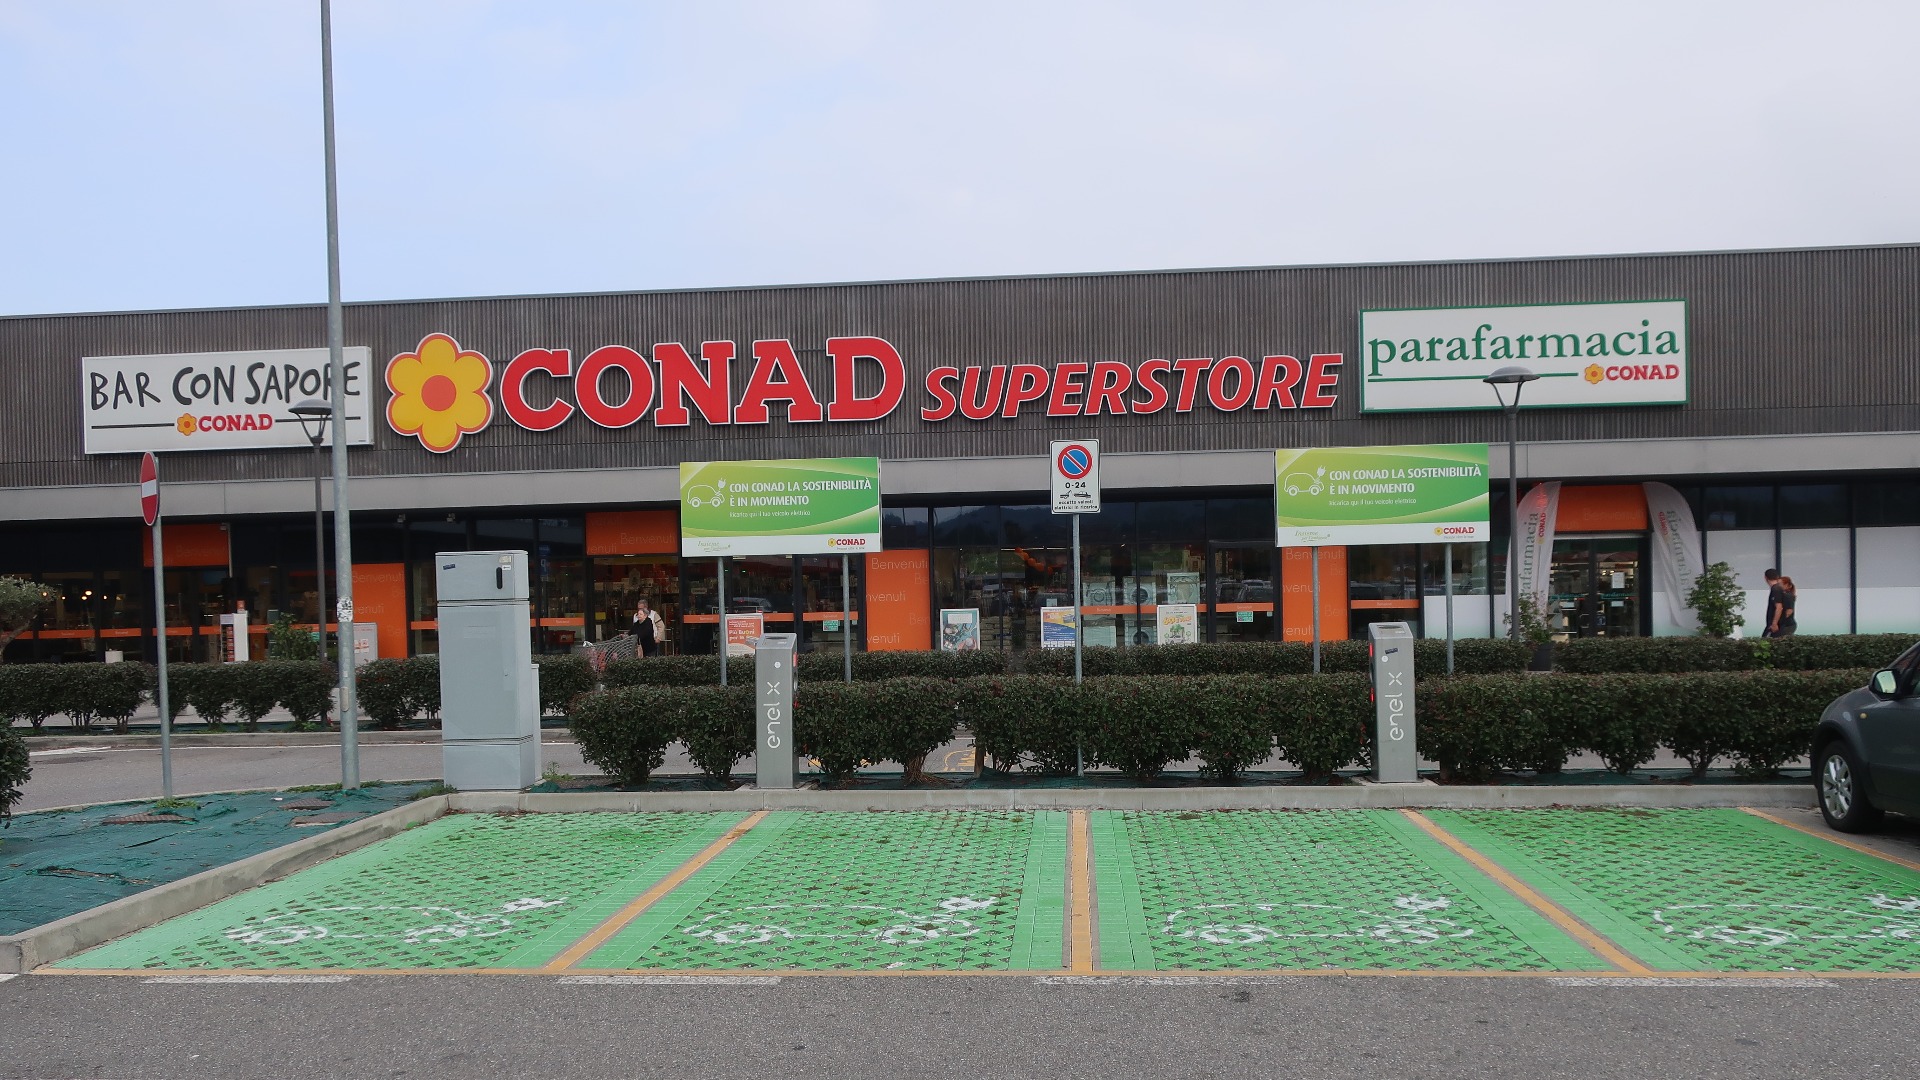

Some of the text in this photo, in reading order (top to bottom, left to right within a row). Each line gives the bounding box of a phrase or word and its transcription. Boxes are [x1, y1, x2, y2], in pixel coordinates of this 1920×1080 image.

[1368, 319, 1680, 376] parafarmacia
[1606, 364, 1680, 380] CONAD
[90, 371, 161, 410] BAR
[172, 364, 236, 405] CON
[500, 336, 1343, 431] CONAD SUPERSTORE
[198, 414, 273, 432] CONAD
[1329, 463, 1481, 480] CON CONAD LA SOSTENIBILITÀ
[729, 477, 872, 493] CON CONAD LA SOSTENIBILITÀ
[1065, 481, 1086, 489] 0-24
[1329, 482, 1415, 495] È IN MOVIMENTO
[729, 495, 809, 507] È IN MOVIMENTO
[1443, 526, 1475, 535] CONAD
[836, 537, 866, 546] CONAD
[871, 557, 929, 570] Benvenuti
[1384, 692, 1405, 741] enel
[763, 701, 781, 749] enel
